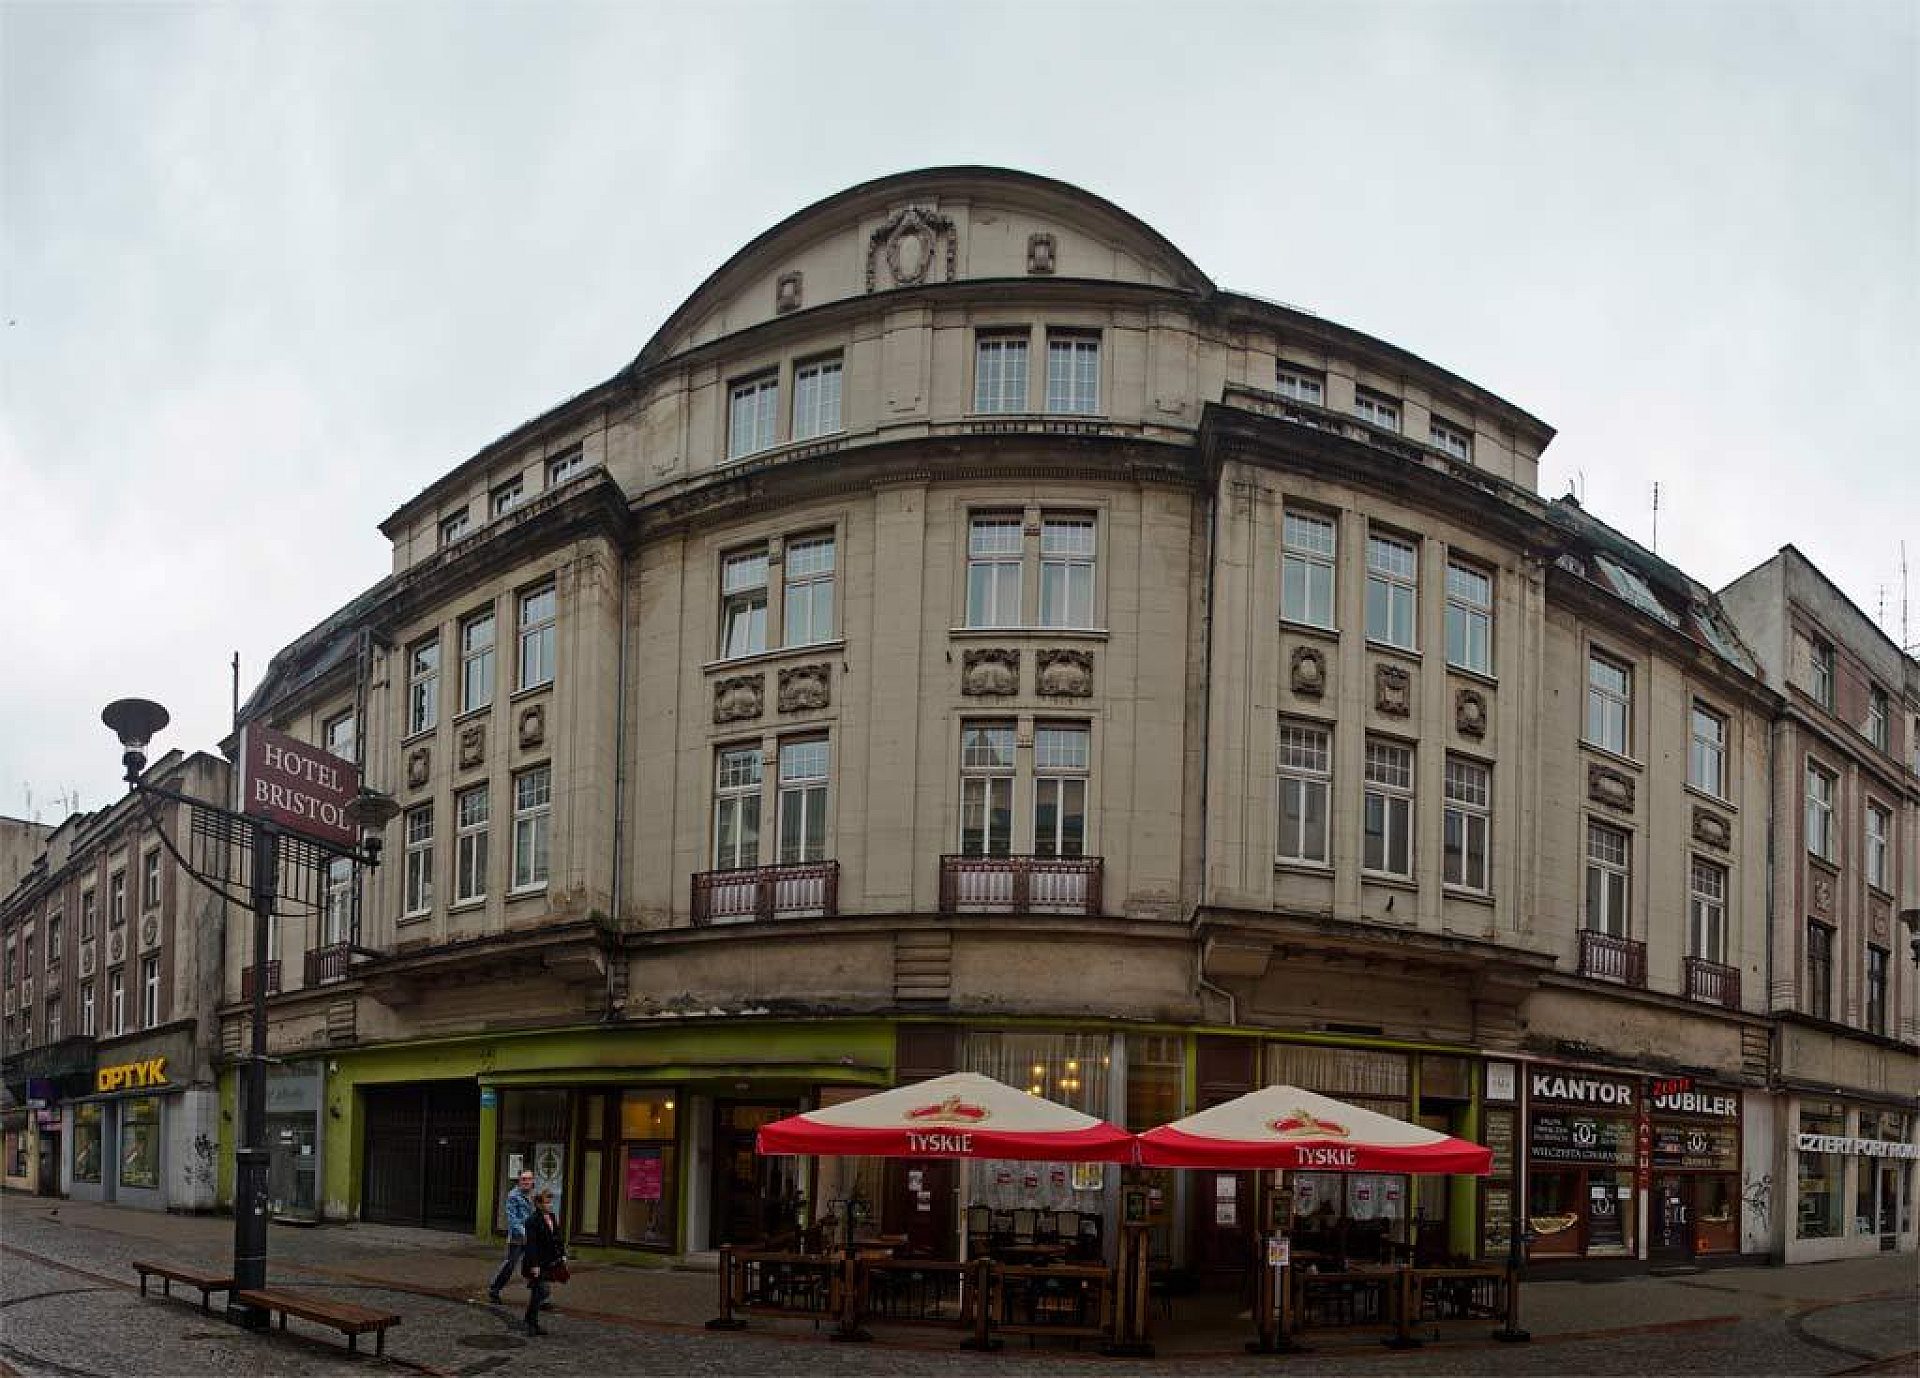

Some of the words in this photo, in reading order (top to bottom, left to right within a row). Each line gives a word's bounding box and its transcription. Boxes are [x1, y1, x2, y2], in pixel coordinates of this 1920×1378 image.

[264, 743, 343, 792] HOTEL
[254, 777, 351, 830] BRISTOL
[98, 1058, 167, 1091] OPTYK
[1533, 1074, 1632, 1104] KANTOR
[1655, 1093, 1737, 1116] JUBILER
[906, 1133, 973, 1152] TYSKIE
[1294, 1145, 1358, 1167] TYSKIE
